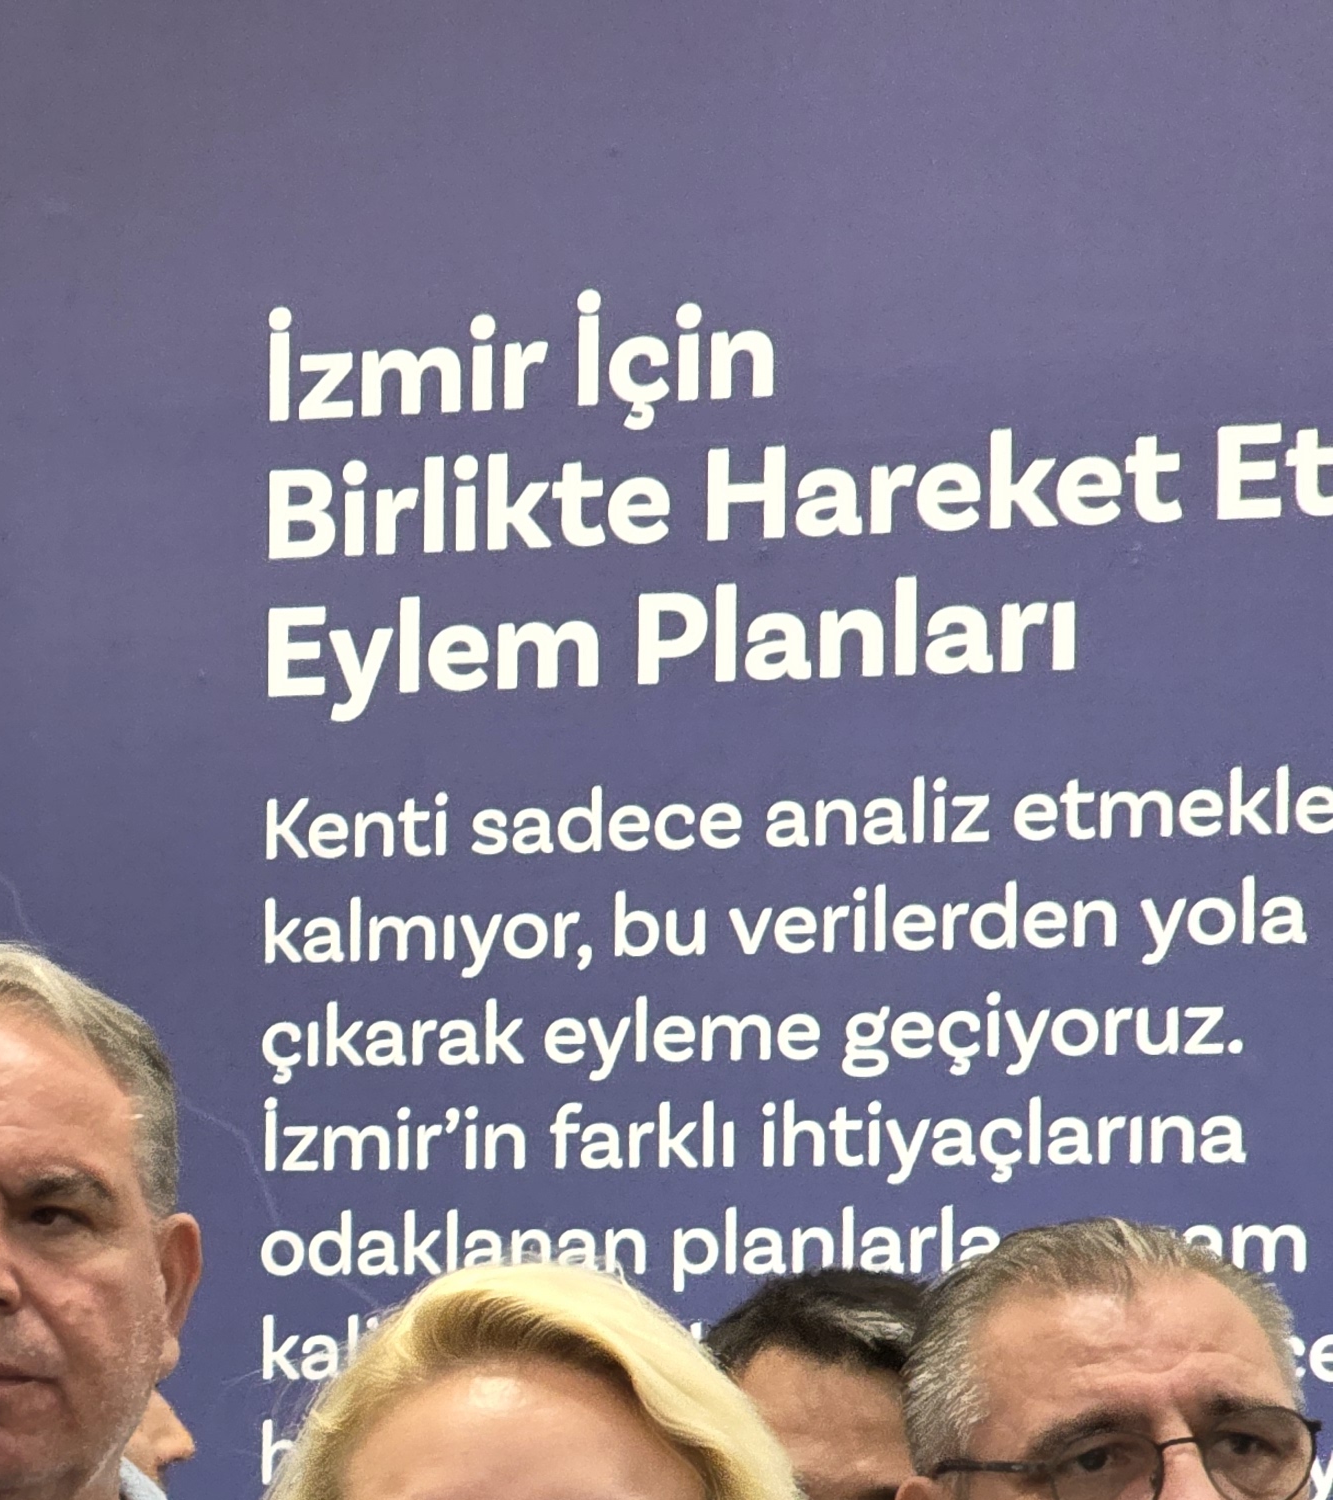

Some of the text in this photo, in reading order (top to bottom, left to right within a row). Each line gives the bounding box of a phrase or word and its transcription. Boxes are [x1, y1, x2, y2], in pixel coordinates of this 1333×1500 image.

[268, 288, 775, 431] İzmir İçin
[268, 452, 671, 560] Birlikte
[706, 428, 1183, 546] Hareket
[268, 574, 1076, 723] Eylem Planları
[265, 791, 448, 861] Kenti
[471, 784, 743, 857] sadece
[765, 775, 990, 852] analiz
[264, 874, 1308, 979] kalmıyor, bu verilerden yola
[261, 990, 1244, 1085] çıkarak eyleme geçiyoruz.
[549, 1098, 735, 1170] farklı
[762, 1094, 1247, 1186] ihtiyaçlarına
[260, 1208, 647, 1277] odaklanan
